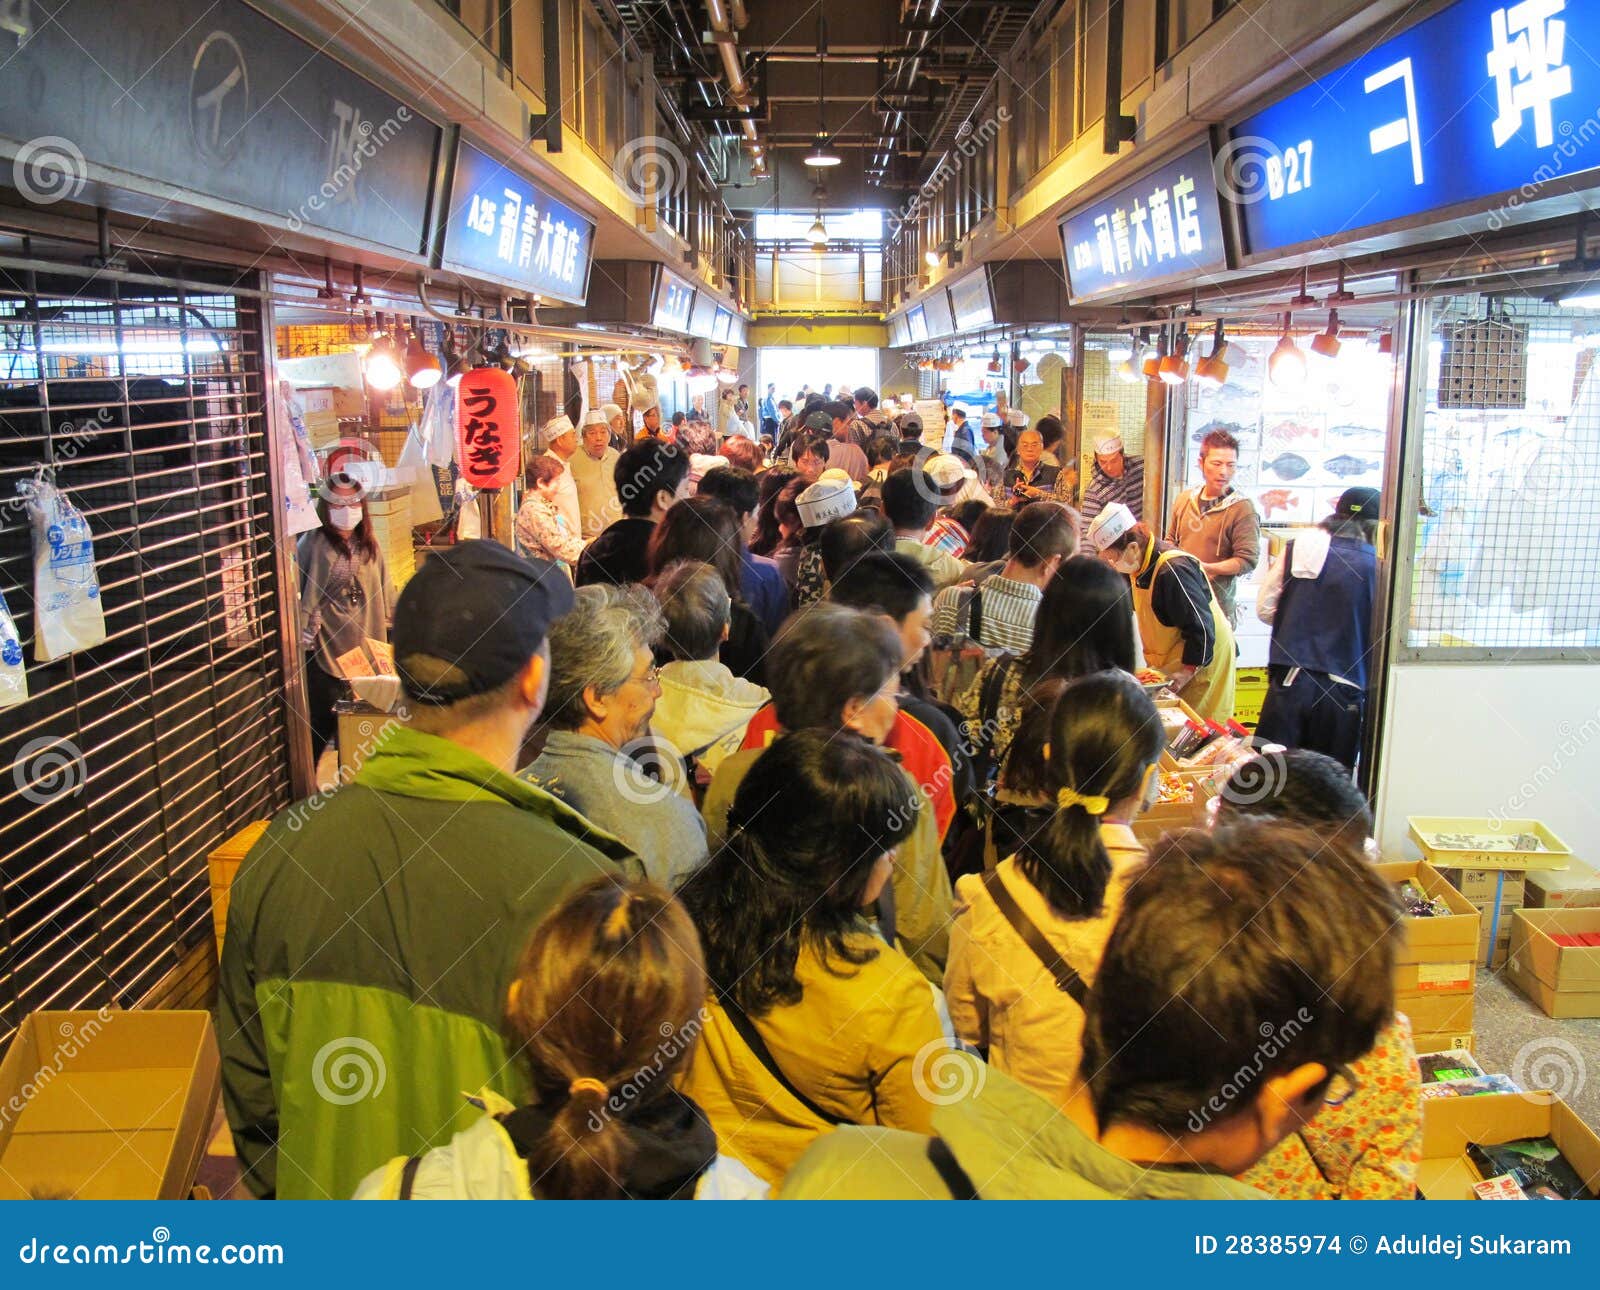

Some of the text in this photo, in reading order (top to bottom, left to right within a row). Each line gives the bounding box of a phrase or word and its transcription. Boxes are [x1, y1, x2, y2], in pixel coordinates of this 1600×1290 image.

[1486, 0, 1573, 149] 坪
[1266, 138, 1313, 201] B27
[466, 194, 497, 237] A25
[463, 388, 503, 476] うなぎ
